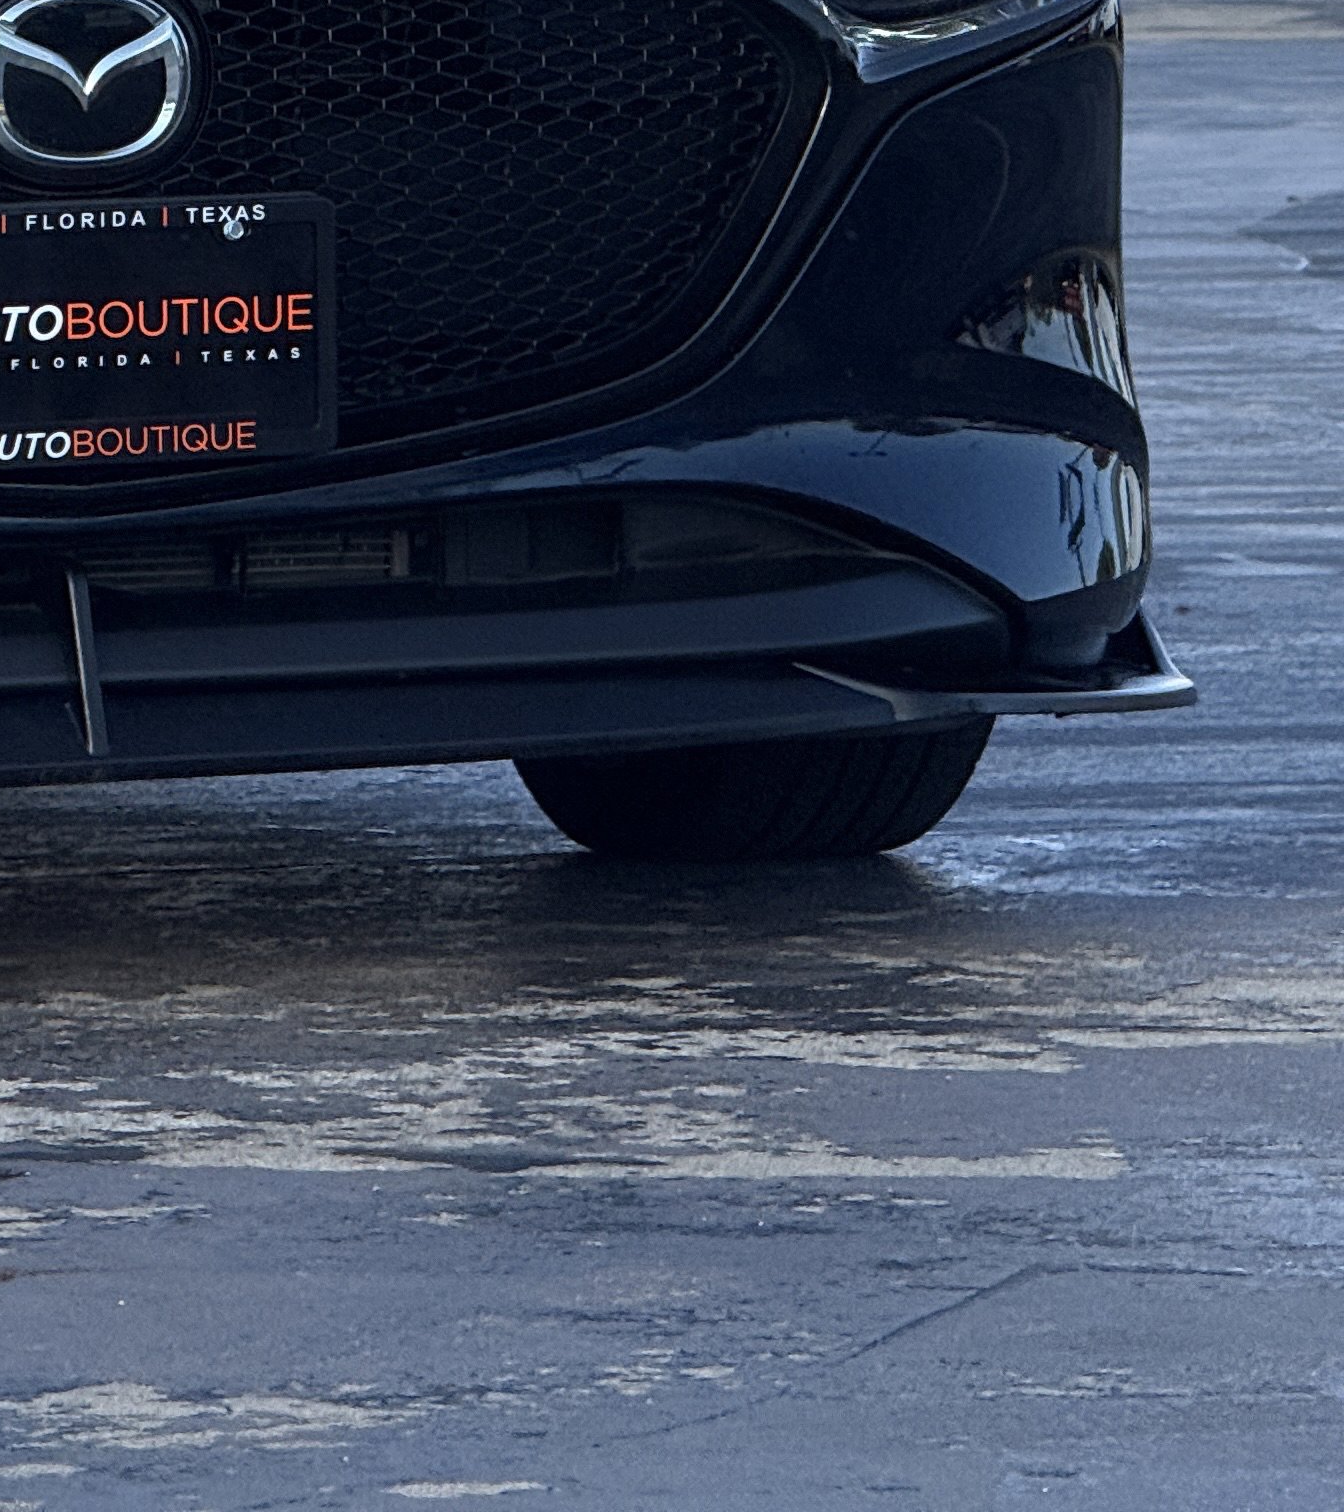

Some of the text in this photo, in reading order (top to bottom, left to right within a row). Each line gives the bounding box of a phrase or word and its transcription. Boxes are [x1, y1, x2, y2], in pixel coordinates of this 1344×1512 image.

[25, 210, 147, 231] FLORIDA
[185, 204, 266, 223] TEXAS
[10, 353, 151, 371] FLORIDA
[200, 346, 301, 363] TEXAS
